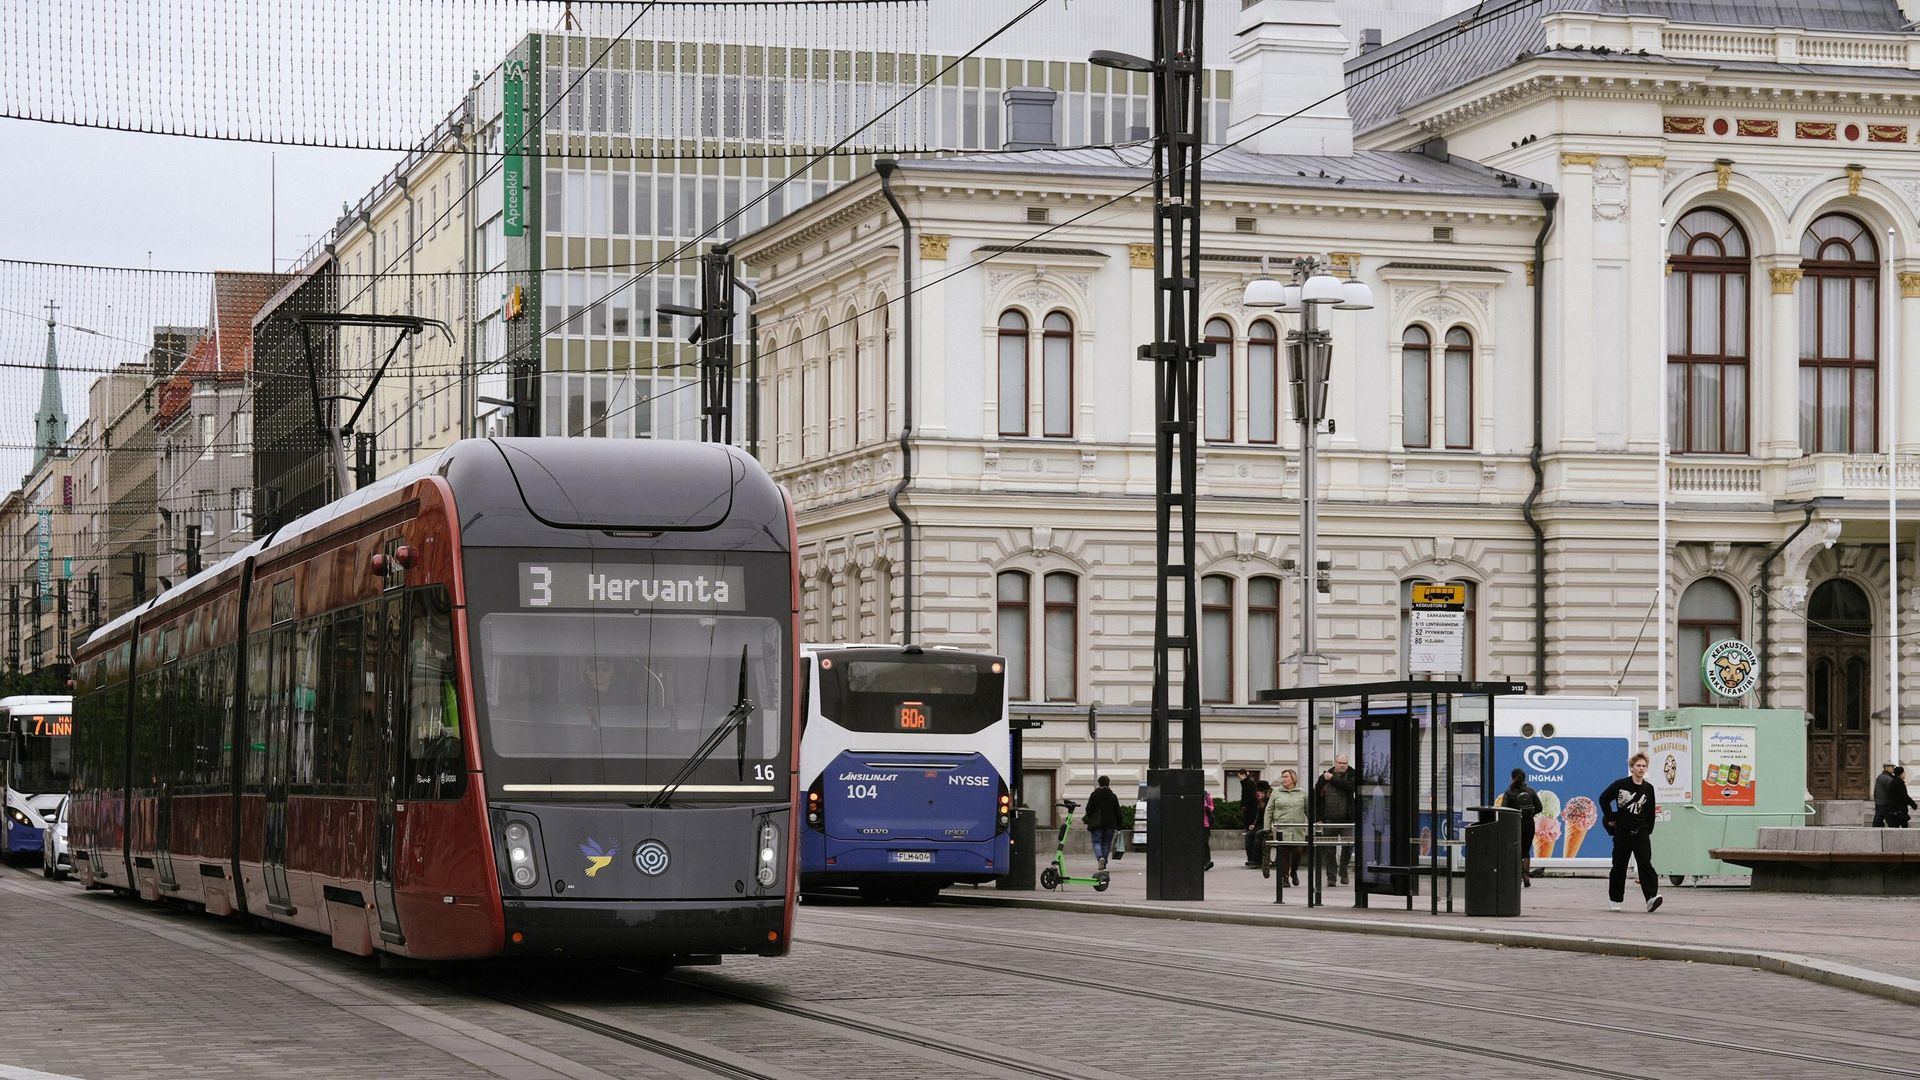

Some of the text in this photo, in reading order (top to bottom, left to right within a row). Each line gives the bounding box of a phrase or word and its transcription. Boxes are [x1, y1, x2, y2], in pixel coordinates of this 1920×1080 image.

[505, 169, 518, 226] Apteekki
[530, 566, 729, 606] 3 Hervanta
[1414, 637, 1422, 645] 80
[1415, 628, 1423, 636] 52
[1711, 642, 1757, 666] KESKUSTORIN
[1708, 669, 1755, 695] NAKKIFAKIIRI
[33, 716, 72, 735] 7 LINN
[901, 708, 925, 728] 80A
[754, 764, 775, 781] 16
[948, 775, 990, 787] NYSSE
[1528, 774, 1564, 782] INGMAN
[847, 784, 878, 799] 104
